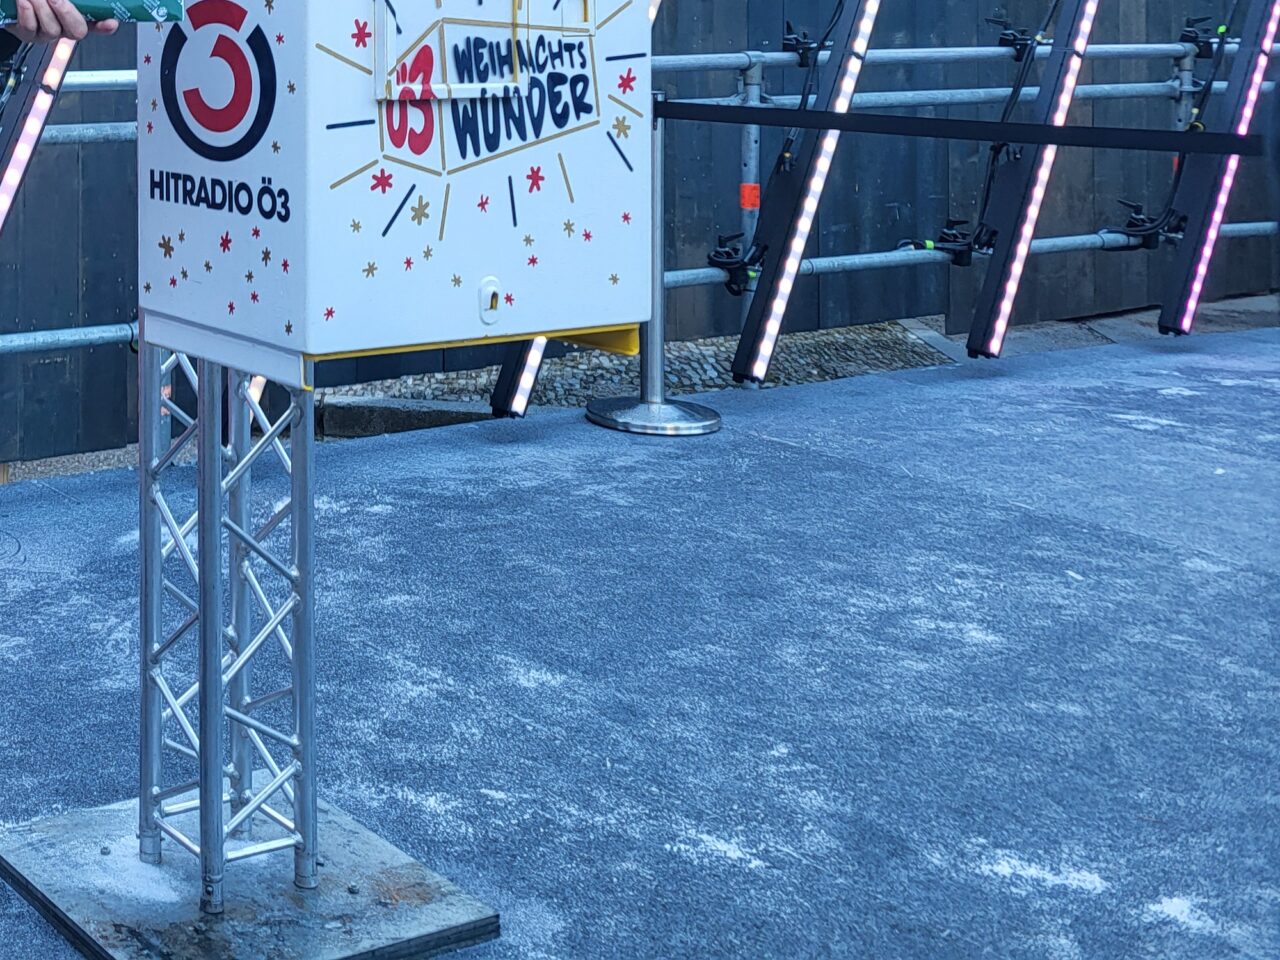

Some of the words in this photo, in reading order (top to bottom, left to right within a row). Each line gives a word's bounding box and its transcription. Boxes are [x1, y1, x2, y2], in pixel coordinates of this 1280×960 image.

[450, 72, 595, 160] WUNDER
[149, 168, 253, 215] HITRADIO
[257, 176, 291, 223] Ö3
